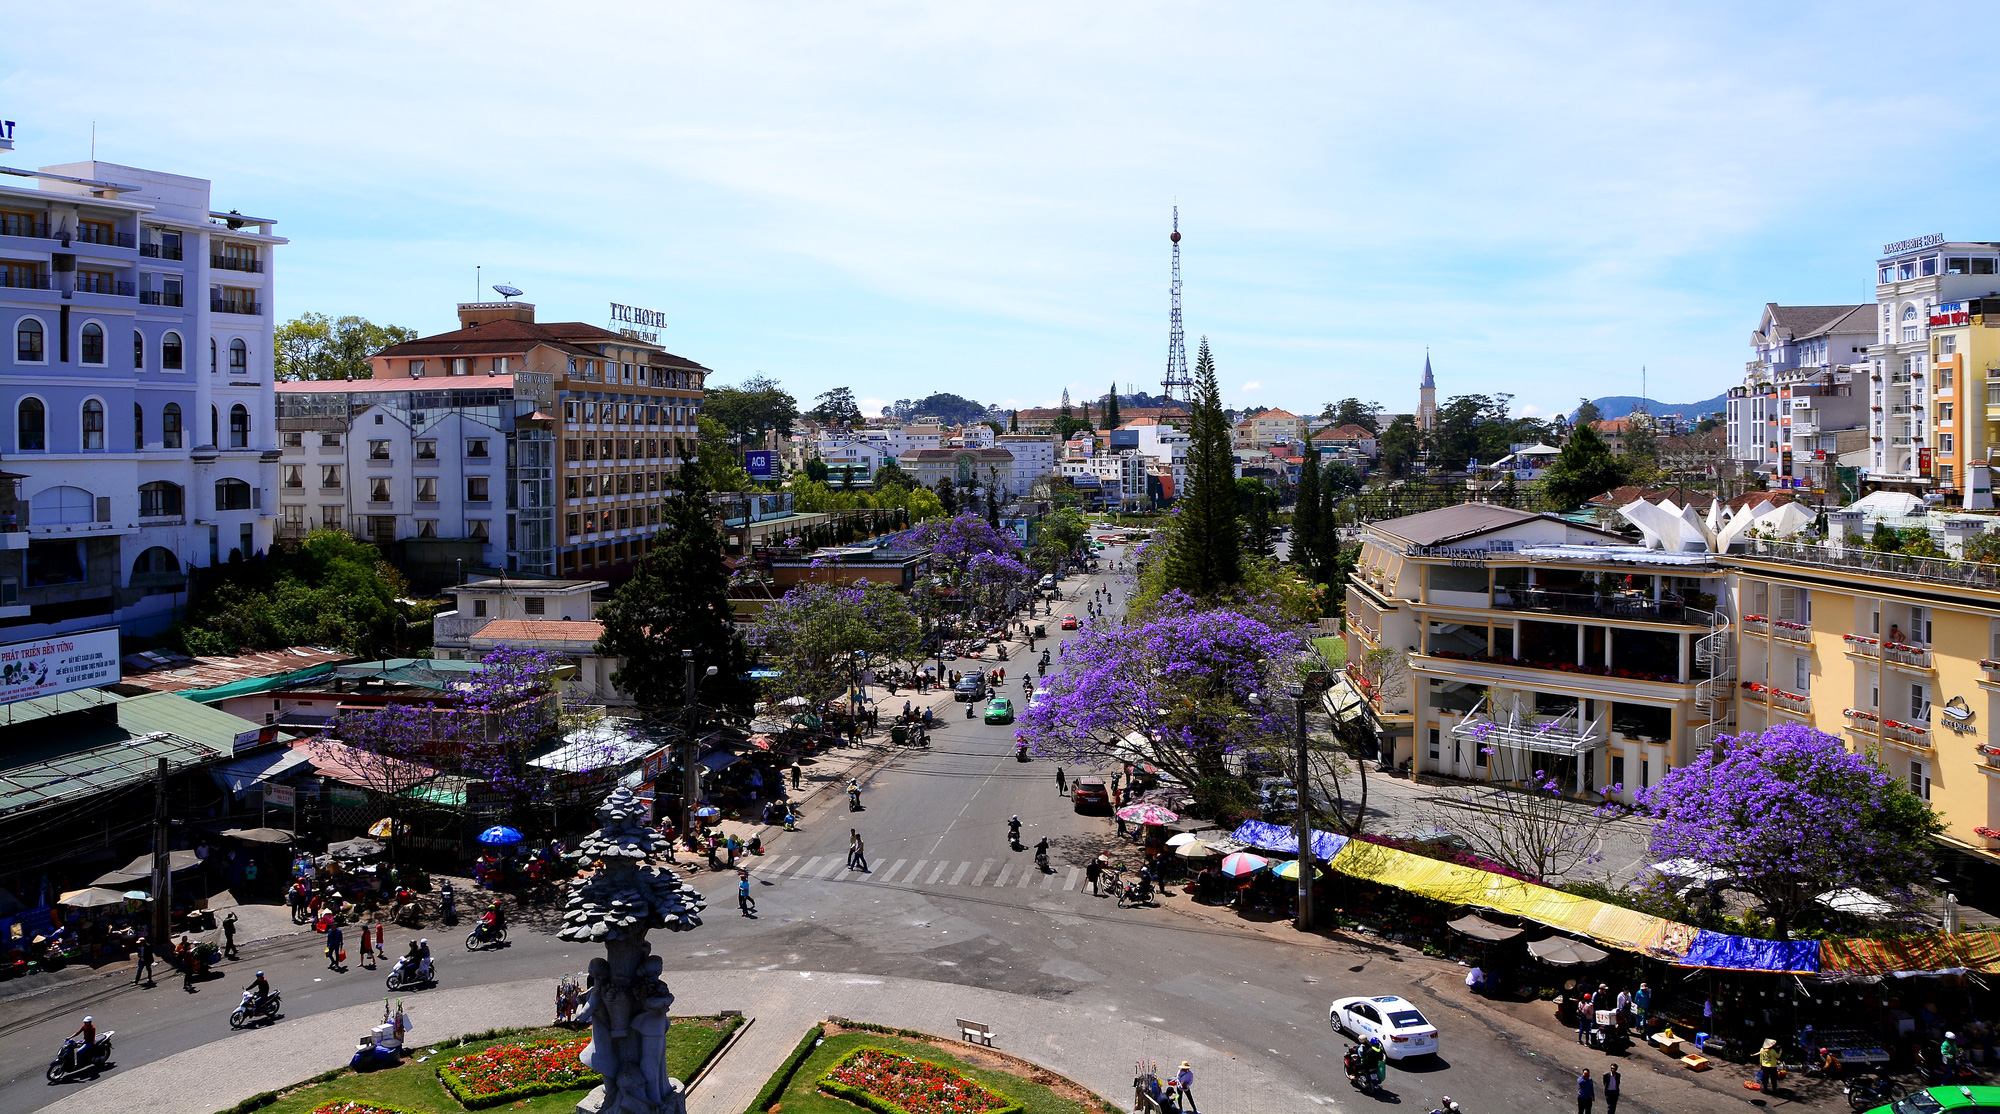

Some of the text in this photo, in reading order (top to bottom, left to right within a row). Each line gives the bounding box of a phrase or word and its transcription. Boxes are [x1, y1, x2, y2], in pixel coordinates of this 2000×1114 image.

[1924, 233, 1945, 246] HOTEL
[610, 302, 667, 328] TTC HOTEL
[751, 456, 765, 467] ACB
[1499, 457, 1556, 470] mobifo
[1407, 544, 1485, 560] NICE DREAM
[1450, 560, 1486, 569] HOTEL
[1, 641, 74, 661] PHÁT TRIỂN BỀN VỮNG
